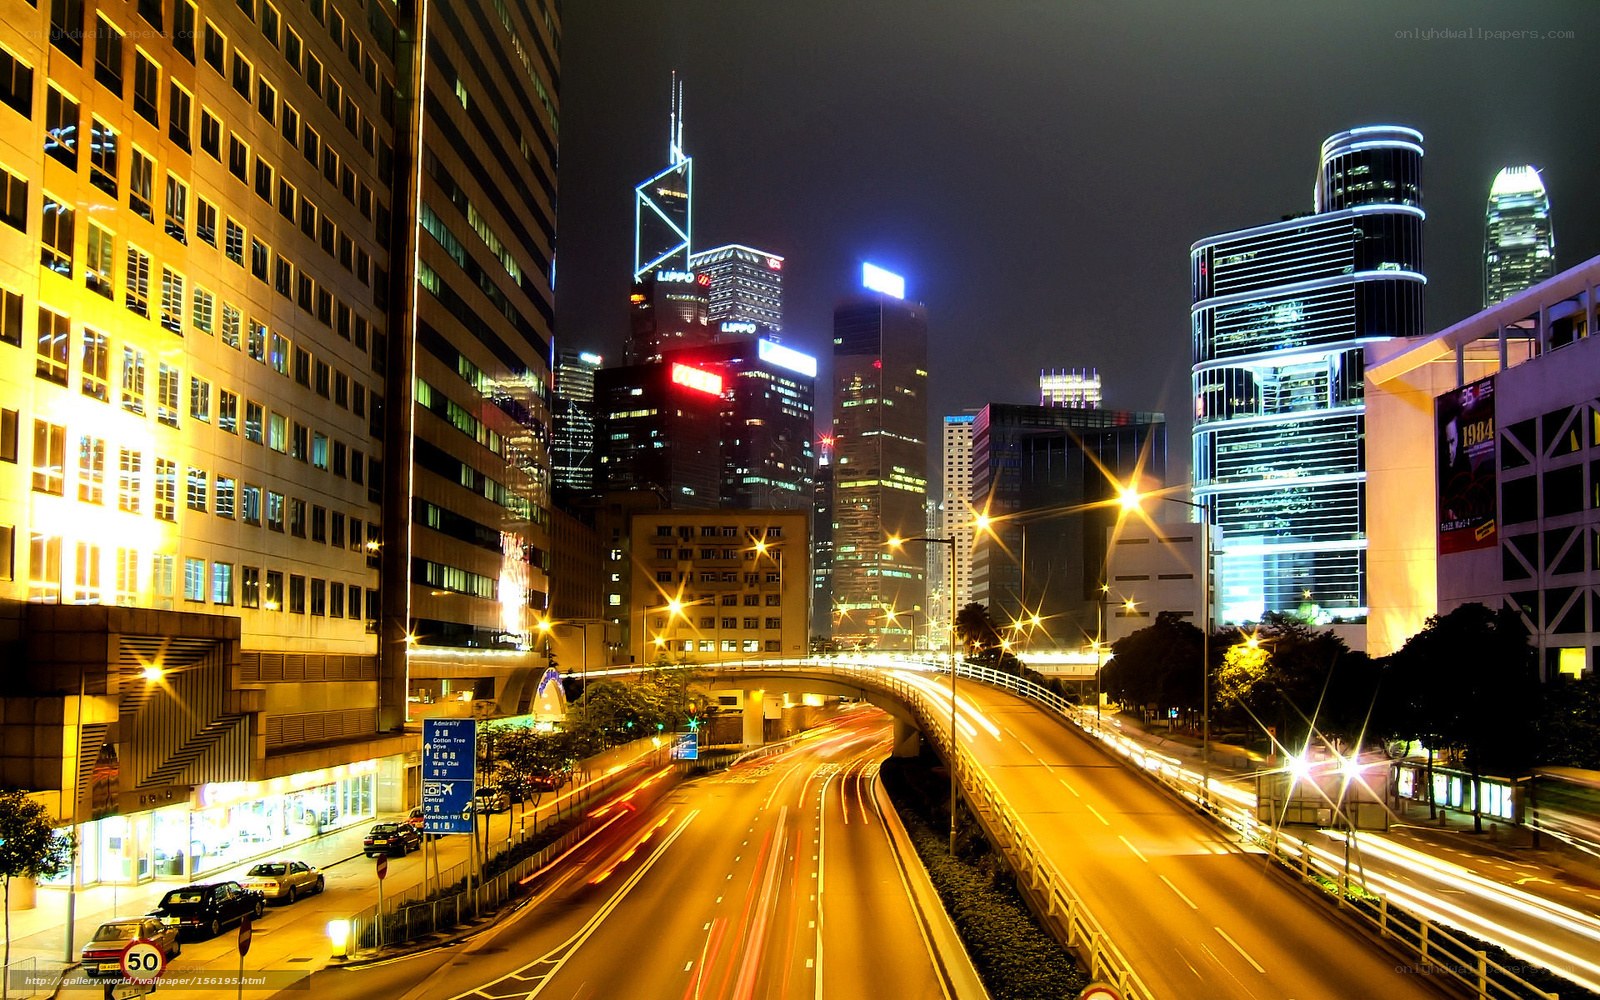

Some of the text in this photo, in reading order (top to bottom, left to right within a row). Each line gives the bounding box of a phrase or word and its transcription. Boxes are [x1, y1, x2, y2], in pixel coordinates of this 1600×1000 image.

[657, 270, 695, 284] LIPPO
[721, 322, 757, 334] LIPPO
[1462, 417, 1494, 447] 1984
[127, 953, 158, 971] 50
